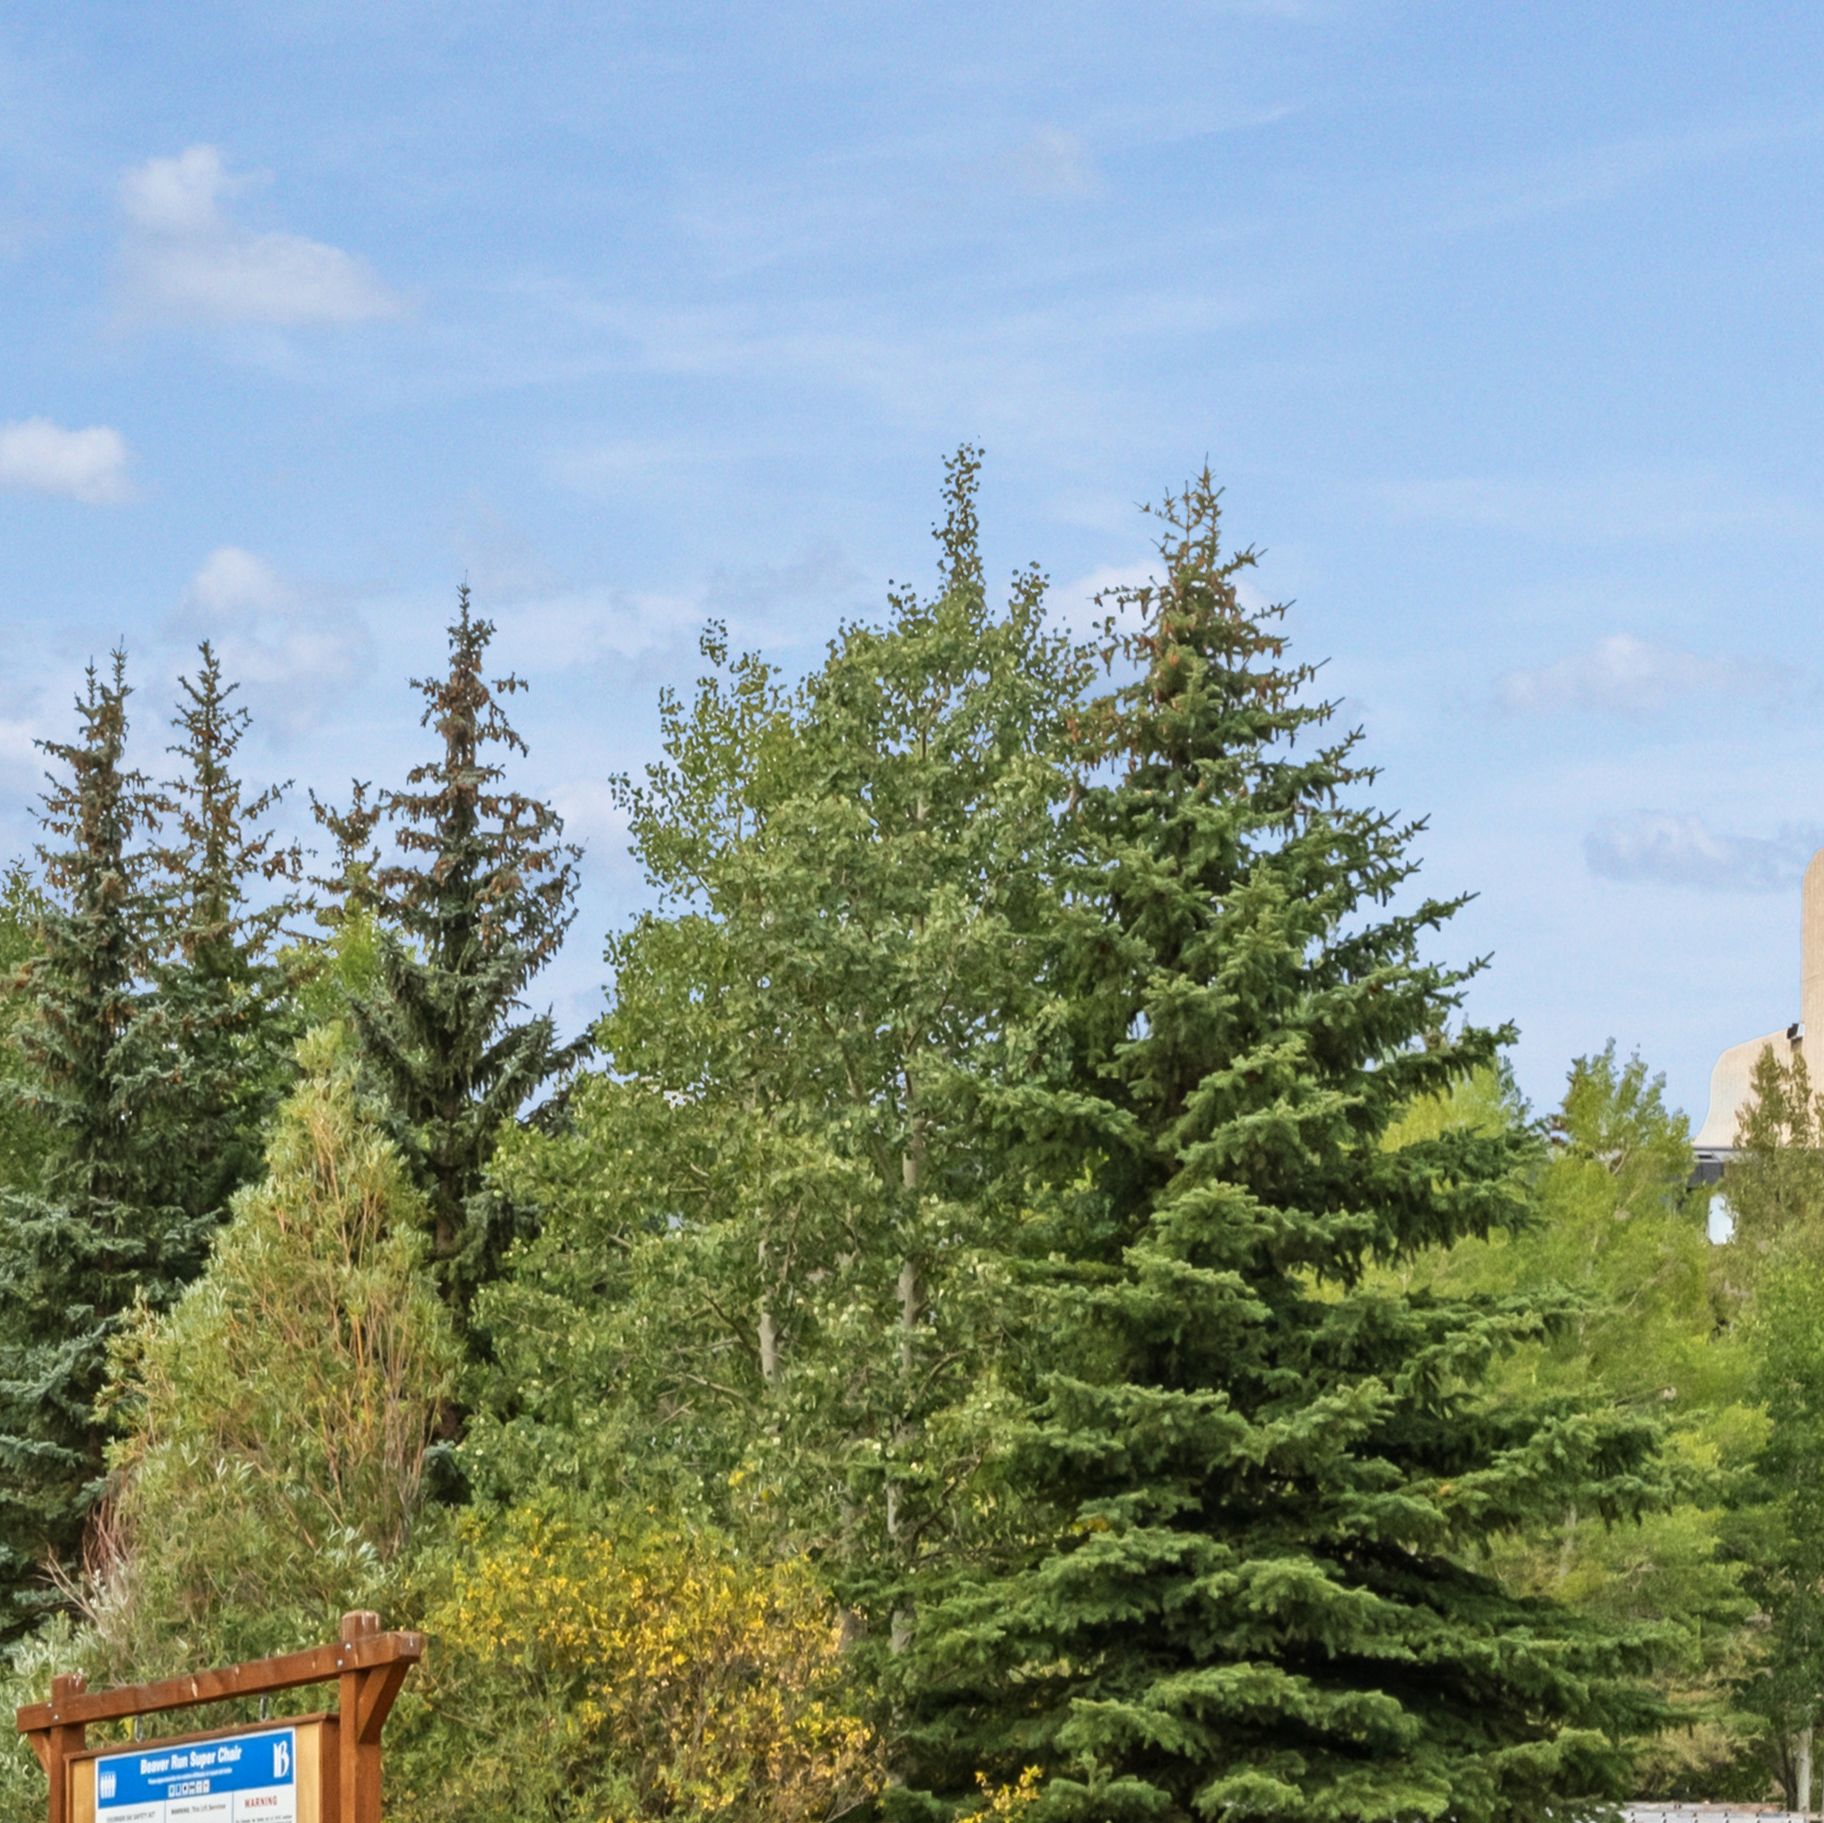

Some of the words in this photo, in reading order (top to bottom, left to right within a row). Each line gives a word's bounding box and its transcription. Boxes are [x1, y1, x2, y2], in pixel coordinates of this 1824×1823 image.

[140, 1758, 170, 1775] Beaver
[171, 1754, 189, 1770] Run
[190, 1750, 216, 1769] Super
[217, 1744, 243, 1763] Chair
